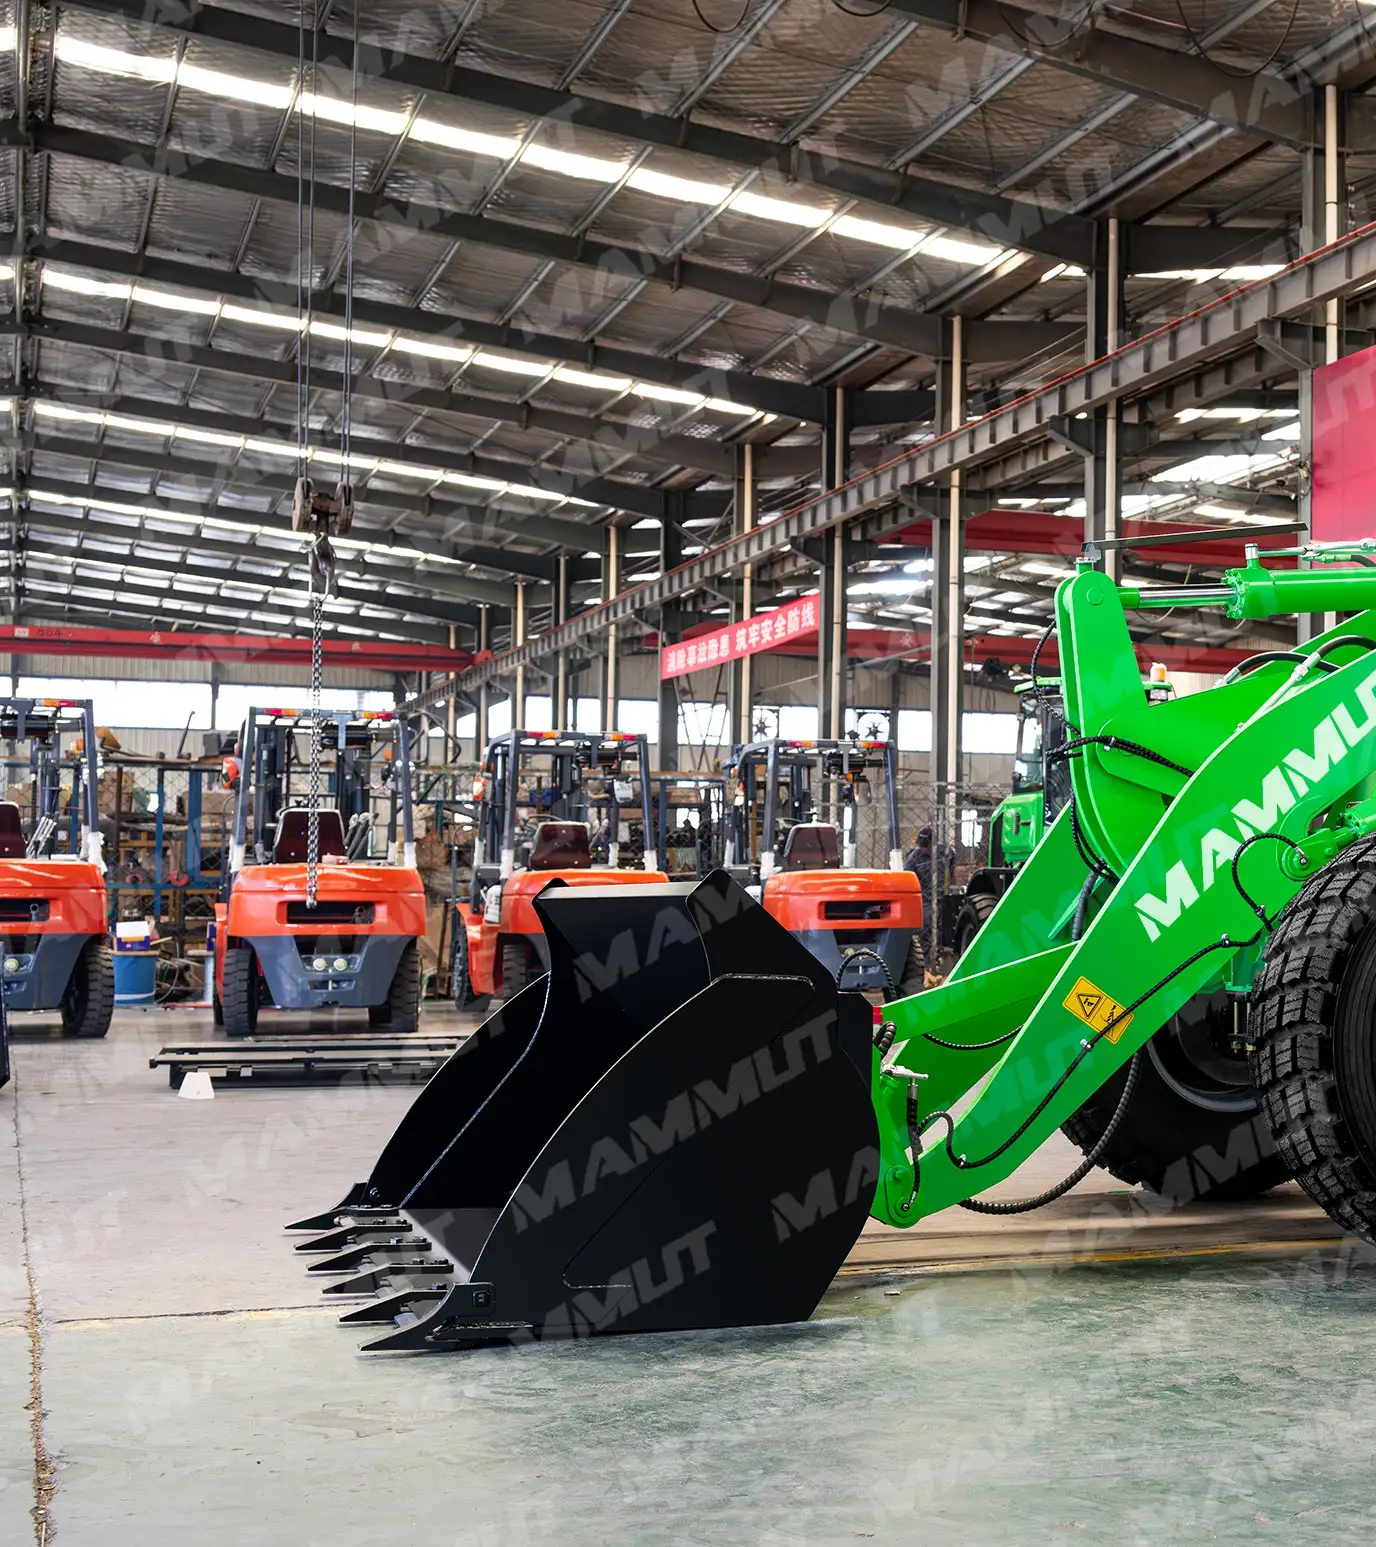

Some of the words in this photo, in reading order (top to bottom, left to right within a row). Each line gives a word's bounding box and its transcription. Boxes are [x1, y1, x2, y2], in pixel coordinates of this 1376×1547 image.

[735, 601, 815, 650] 筑牢安全防线
